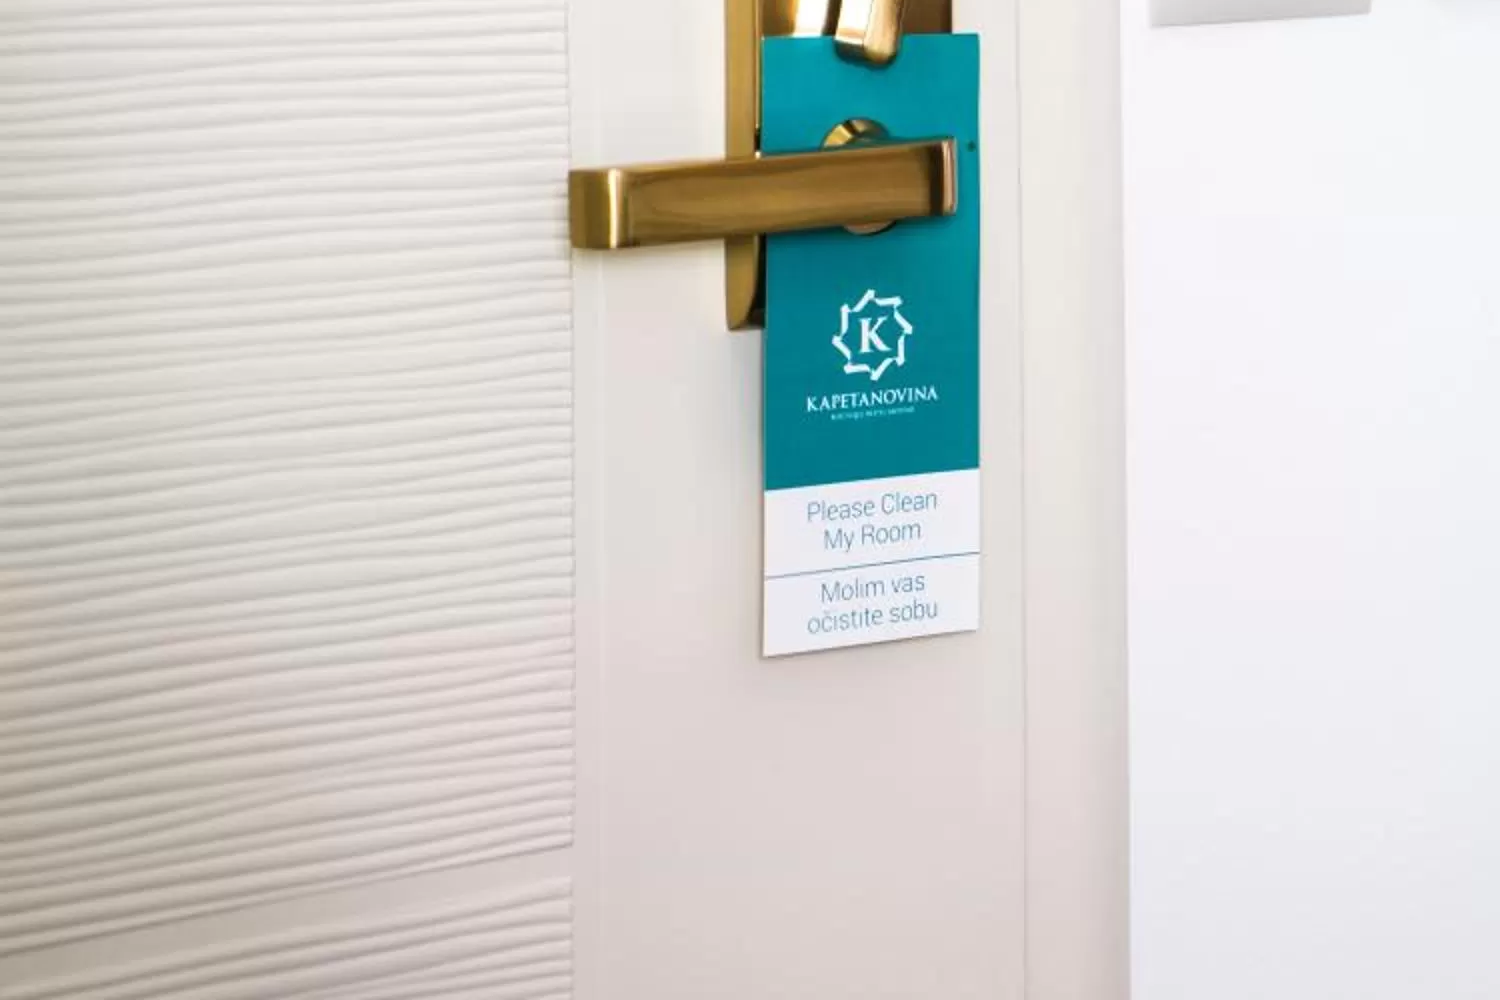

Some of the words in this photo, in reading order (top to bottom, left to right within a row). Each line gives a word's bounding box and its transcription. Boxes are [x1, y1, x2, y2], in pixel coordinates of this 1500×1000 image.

[858, 314, 892, 354] K
[806, 385, 939, 413] KAPETANOVINA
[806, 499, 876, 522] Please
[880, 491, 938, 515] Clean
[823, 527, 855, 553] My
[861, 521, 922, 545] Room
[820, 576, 886, 603] Molim
[891, 574, 926, 594] vas
[806, 607, 884, 635] očistite
[889, 599, 939, 624] sobu
